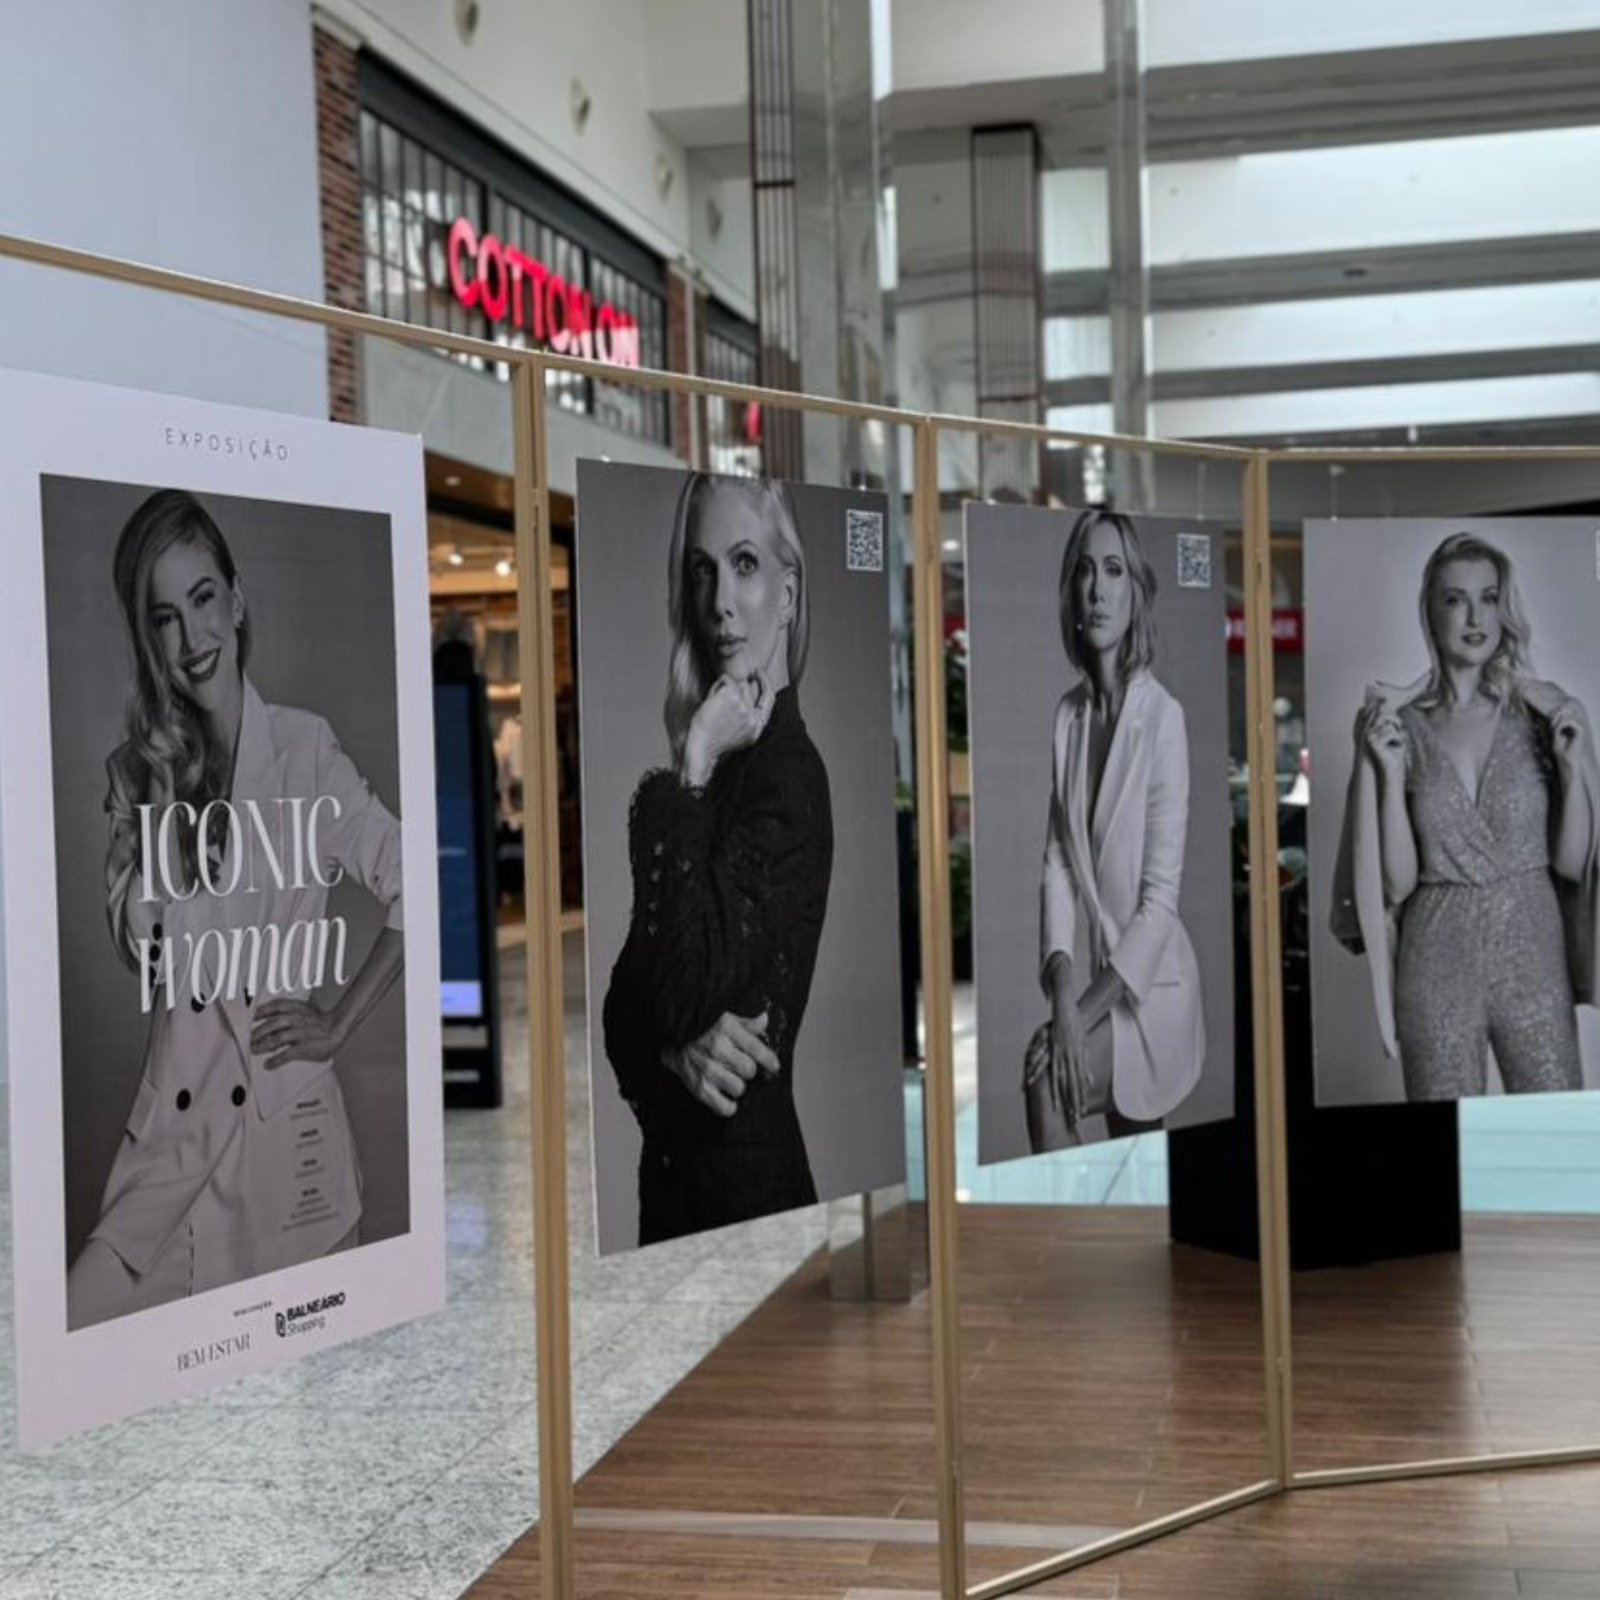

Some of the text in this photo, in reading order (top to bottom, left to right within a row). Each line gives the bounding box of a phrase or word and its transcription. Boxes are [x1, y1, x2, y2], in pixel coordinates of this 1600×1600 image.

[449, 216, 640, 369] COTTON ON
[165, 427, 289, 461] EXPOSIÇÃO
[136, 795, 345, 903] ICONIC
[137, 916, 350, 1014] woman
